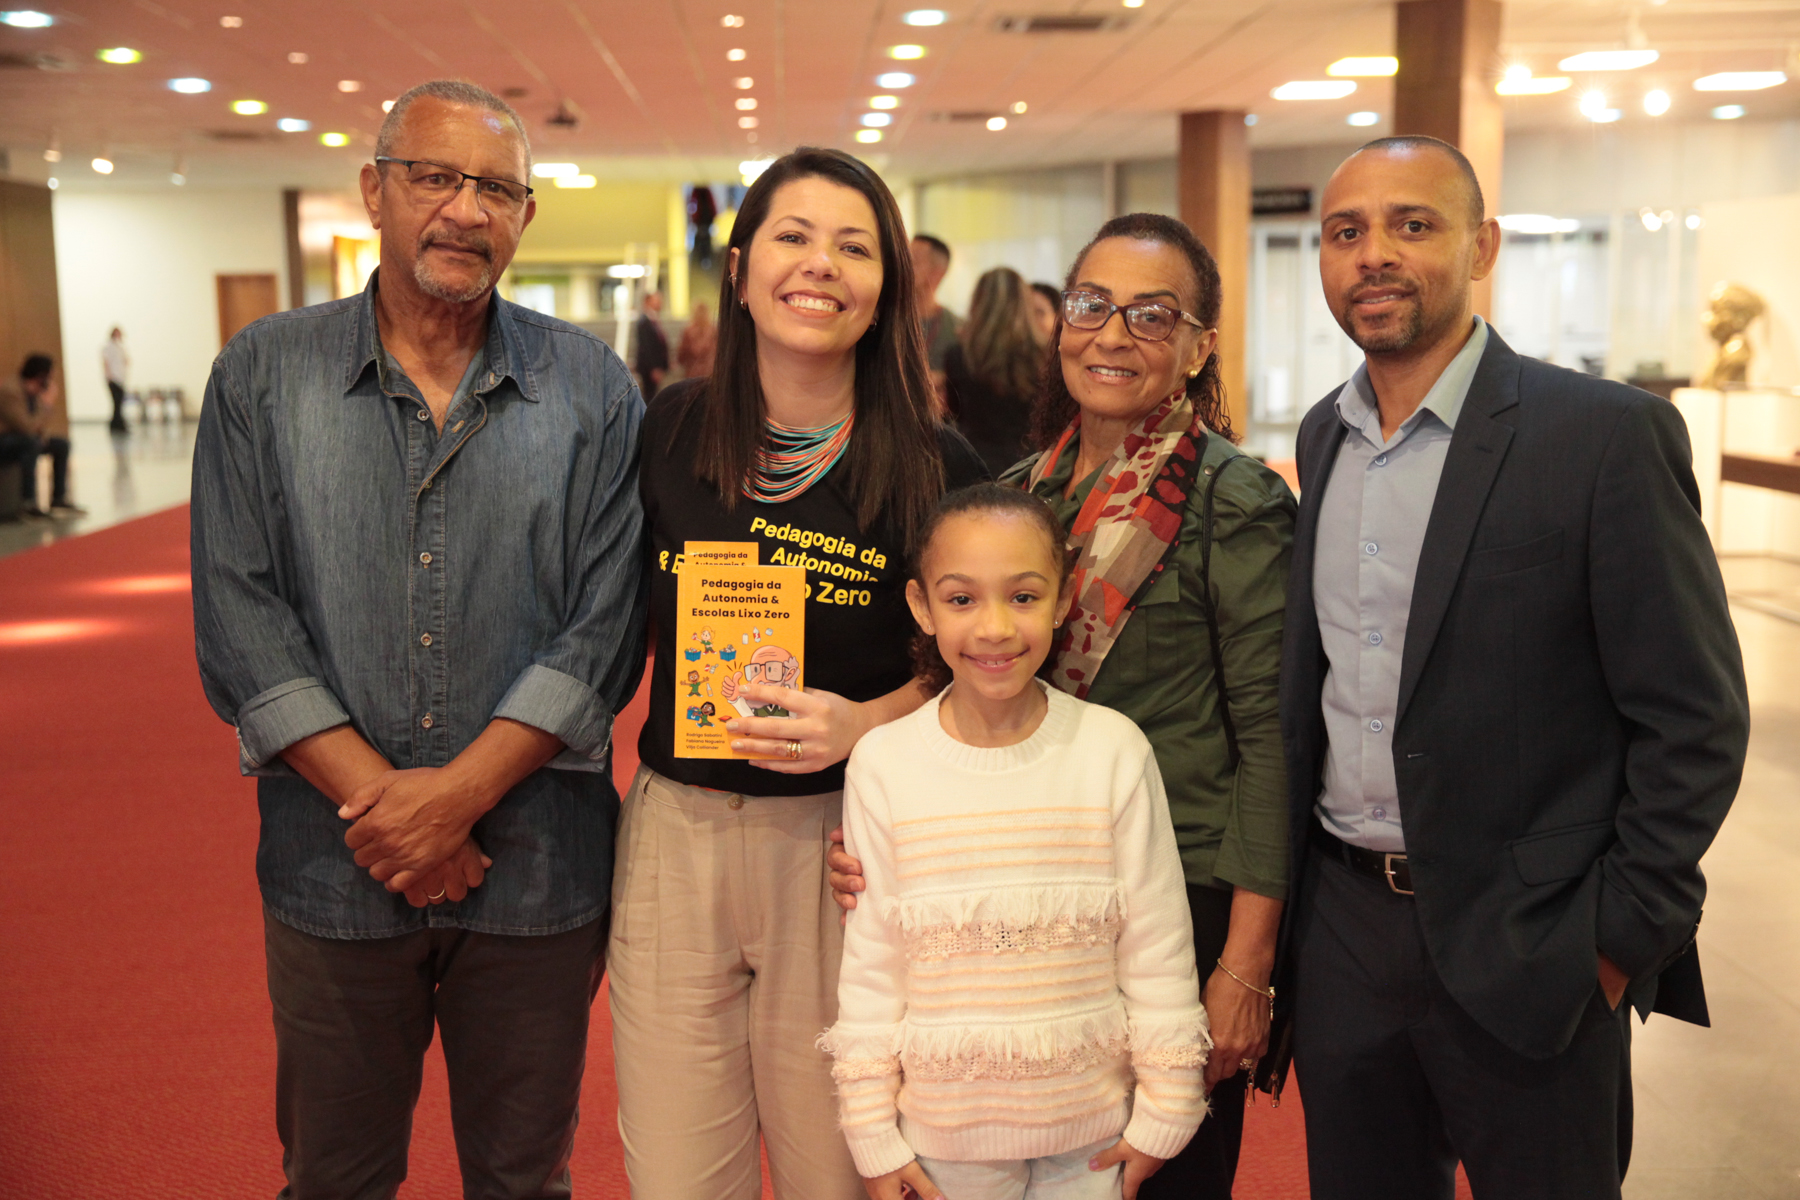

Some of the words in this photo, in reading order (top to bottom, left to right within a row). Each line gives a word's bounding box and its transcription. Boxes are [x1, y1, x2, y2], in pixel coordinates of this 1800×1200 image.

[750, 517, 857, 558] Pedagogia
[860, 547, 887, 570] da
[693, 551, 736, 560] Pedagogia
[701, 579, 764, 591] Pedagogia
[766, 580, 782, 590] da
[702, 593, 768, 604] Autonomia
[771, 595, 780, 604] &
[816, 580, 871, 606] Zero
[691, 607, 736, 618] Escolas
[738, 608, 762, 618] Lixo
[764, 610, 790, 619] Zero
